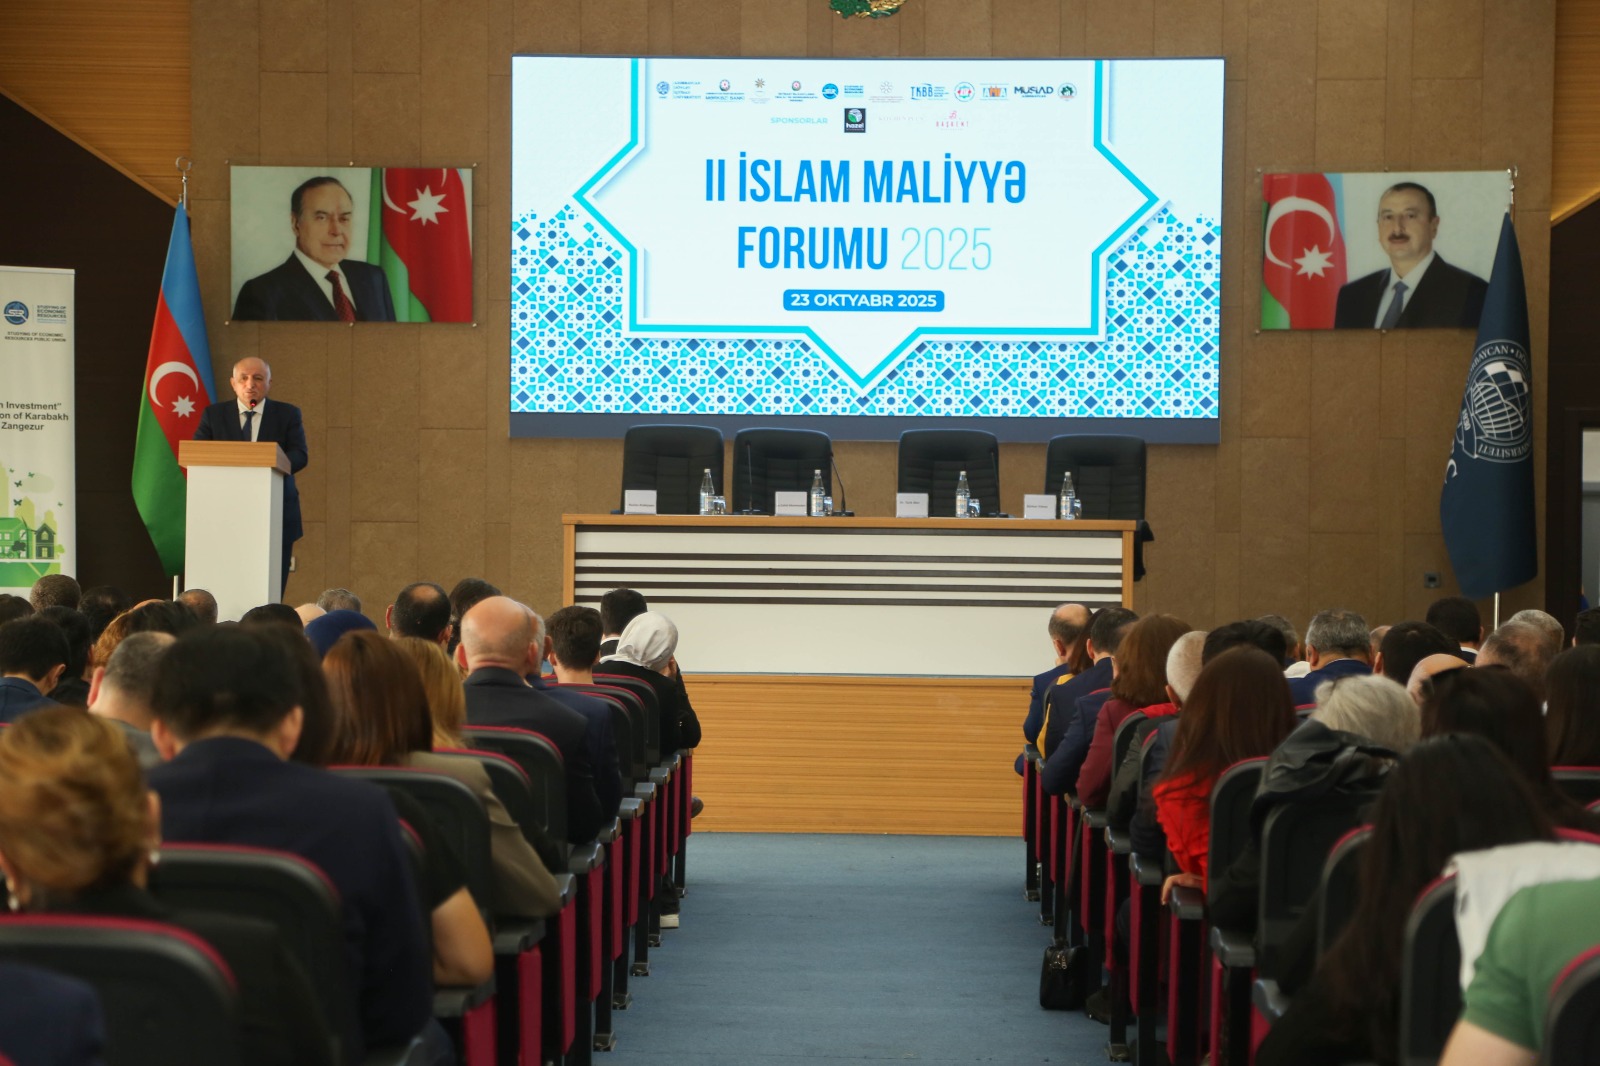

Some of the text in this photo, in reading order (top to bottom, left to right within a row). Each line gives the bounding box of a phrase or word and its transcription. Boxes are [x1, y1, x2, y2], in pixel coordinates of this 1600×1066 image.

[706, 151, 1026, 204] II İSLAM MALİYYƏ
[738, 226, 992, 270] FORUMU 2025
[791, 293, 937, 307] 23 OKTYABR 2025
[25, 412, 69, 421] Karabakh
[1, 422, 45, 432] Zangezur
